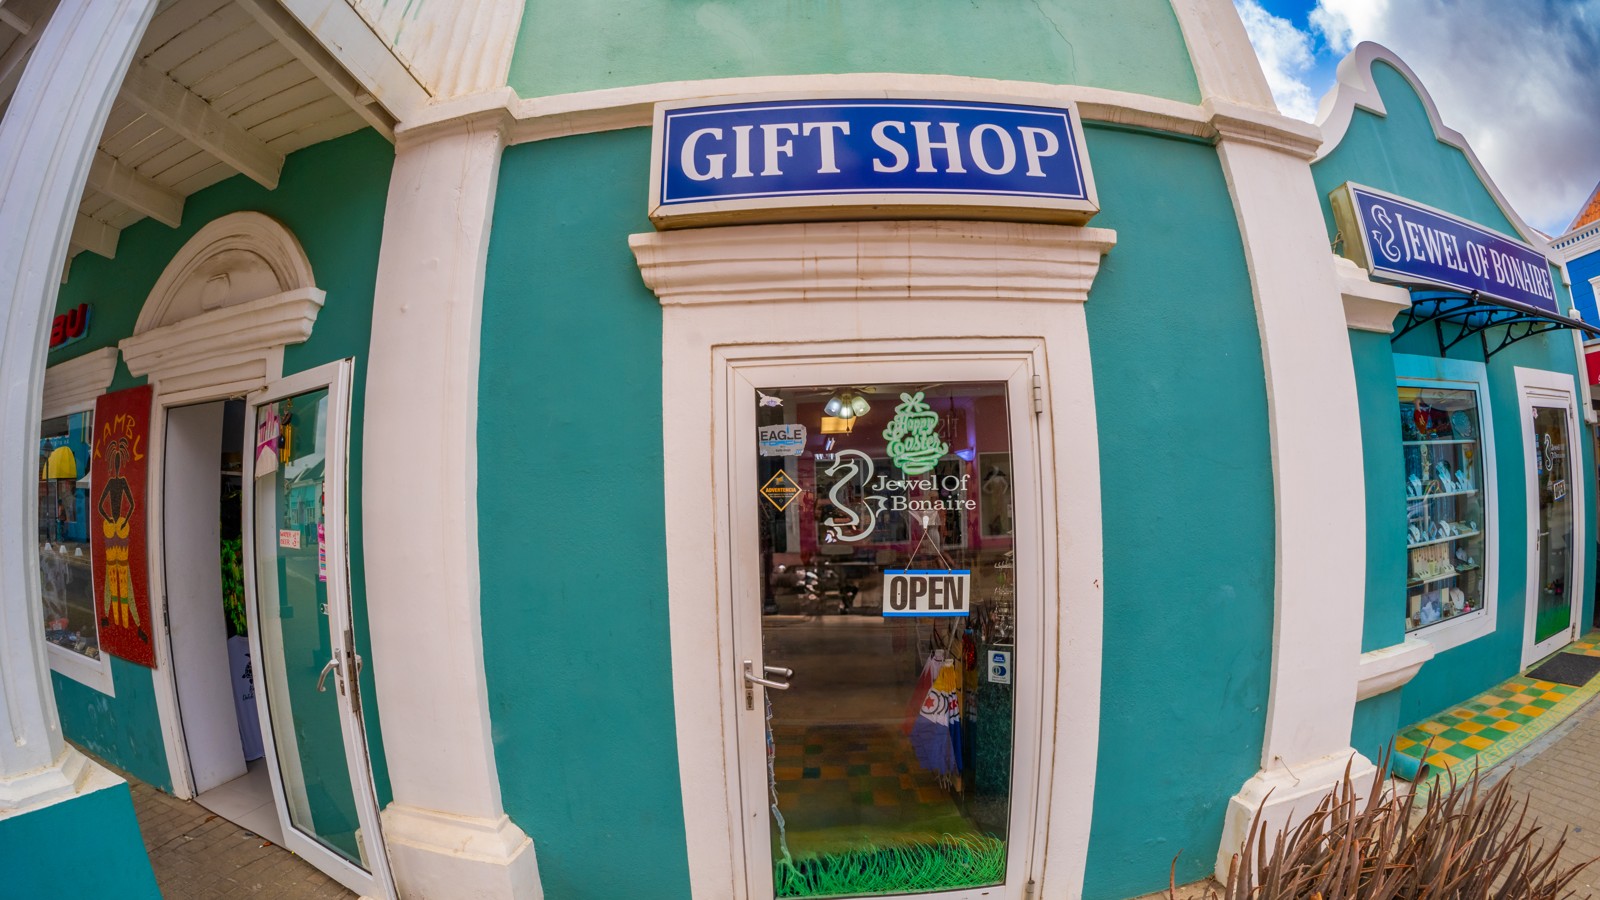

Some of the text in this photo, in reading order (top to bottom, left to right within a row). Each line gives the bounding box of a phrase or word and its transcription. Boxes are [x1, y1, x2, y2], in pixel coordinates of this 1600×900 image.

[680, 120, 1060, 181] GIFT SHOP
[1395, 212, 1553, 301] JEWEL OF BONAIRE
[872, 474, 971, 491] Jewel Of
[890, 495, 976, 511] Bonaire
[889, 576, 964, 611] OPEN
